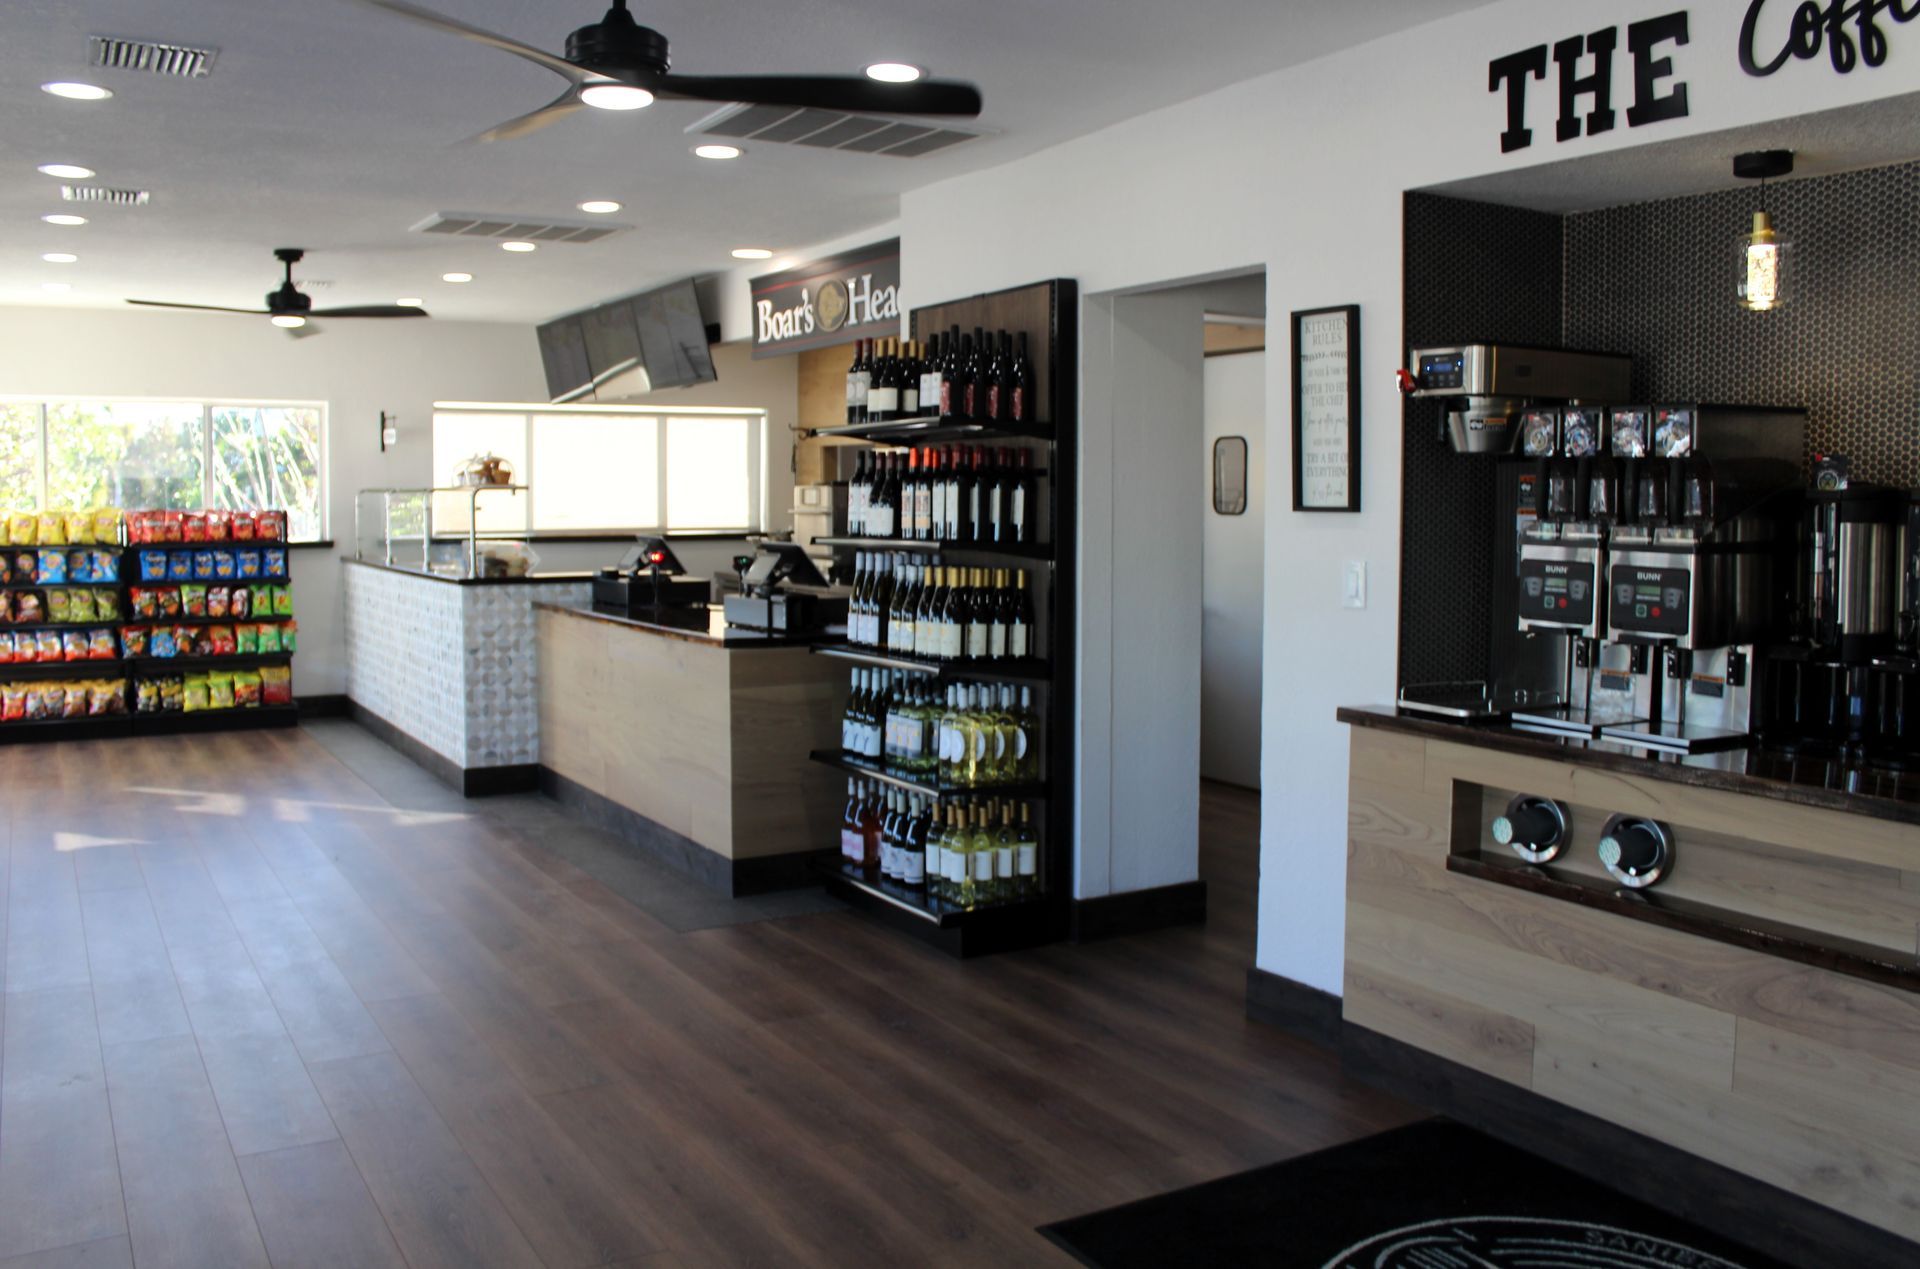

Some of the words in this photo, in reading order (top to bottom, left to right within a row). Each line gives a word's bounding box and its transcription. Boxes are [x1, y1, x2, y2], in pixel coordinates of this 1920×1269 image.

[1489, 10, 1689, 153] THE
[757, 288, 814, 344] Boar's
[847, 273, 900, 325] Hea
[1545, 565, 1567, 574] BUNN
[1637, 571, 1661, 581] BUNN
